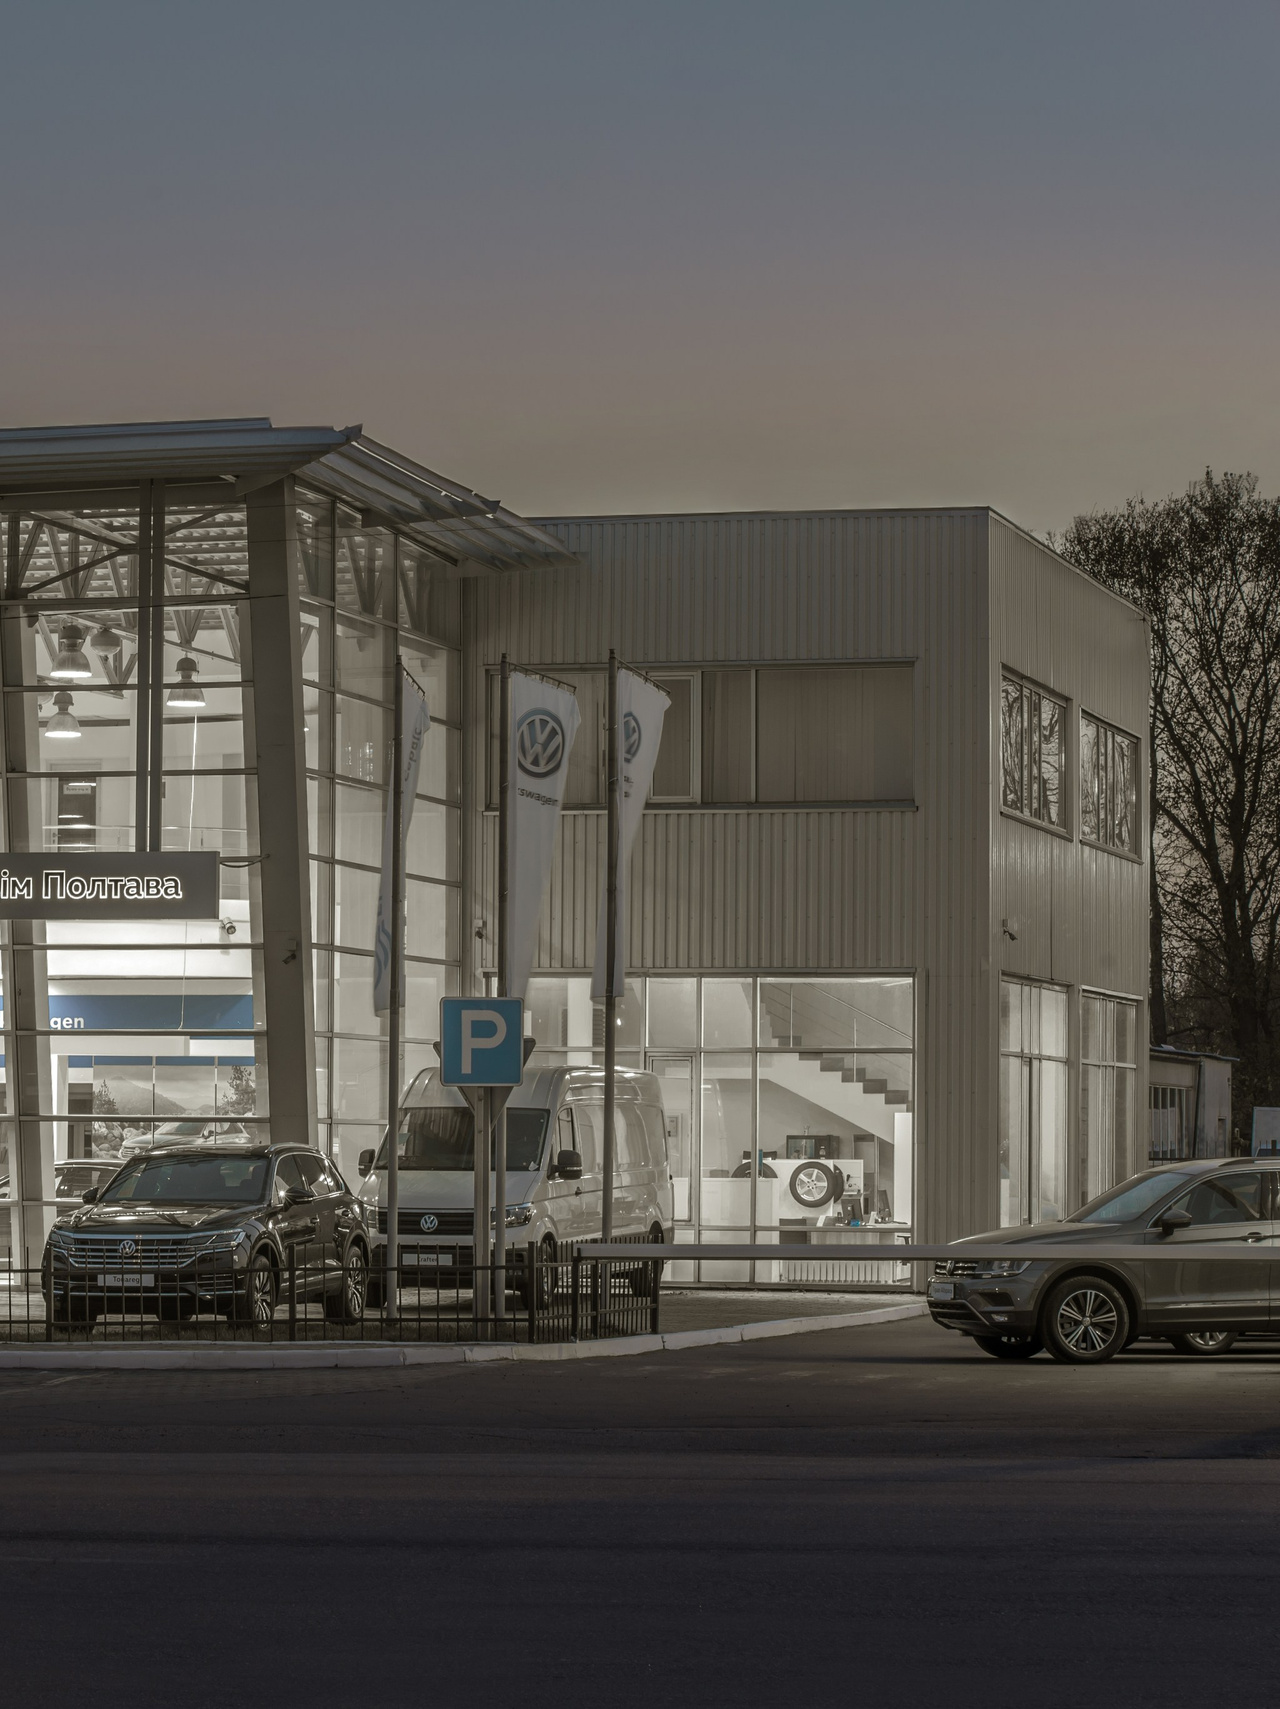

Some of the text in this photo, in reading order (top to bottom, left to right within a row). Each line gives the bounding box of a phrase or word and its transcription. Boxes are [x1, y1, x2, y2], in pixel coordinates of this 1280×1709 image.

[518, 788, 559, 807] swagen
[42, 870, 183, 900] Полтава
[461, 1010, 507, 1074] P
[113, 1275, 140, 1284] Toareg
